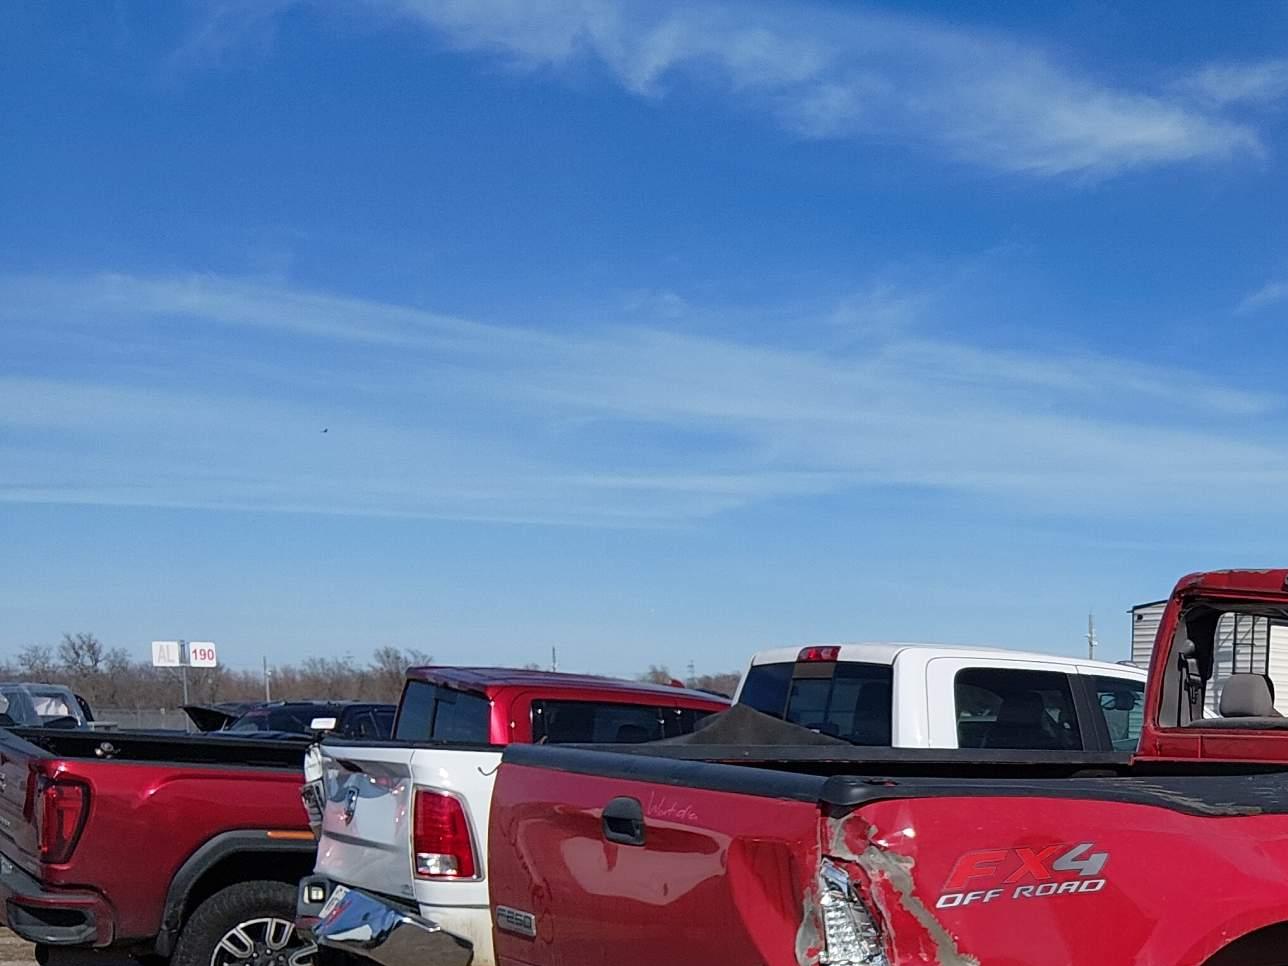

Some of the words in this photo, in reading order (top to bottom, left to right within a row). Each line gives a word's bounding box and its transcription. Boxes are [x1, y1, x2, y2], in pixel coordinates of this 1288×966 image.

[192, 648, 215, 660] 190
[943, 841, 1109, 891] FX4
[936, 888, 1004, 908] OFF
[1012, 879, 1106, 899] ROAD
